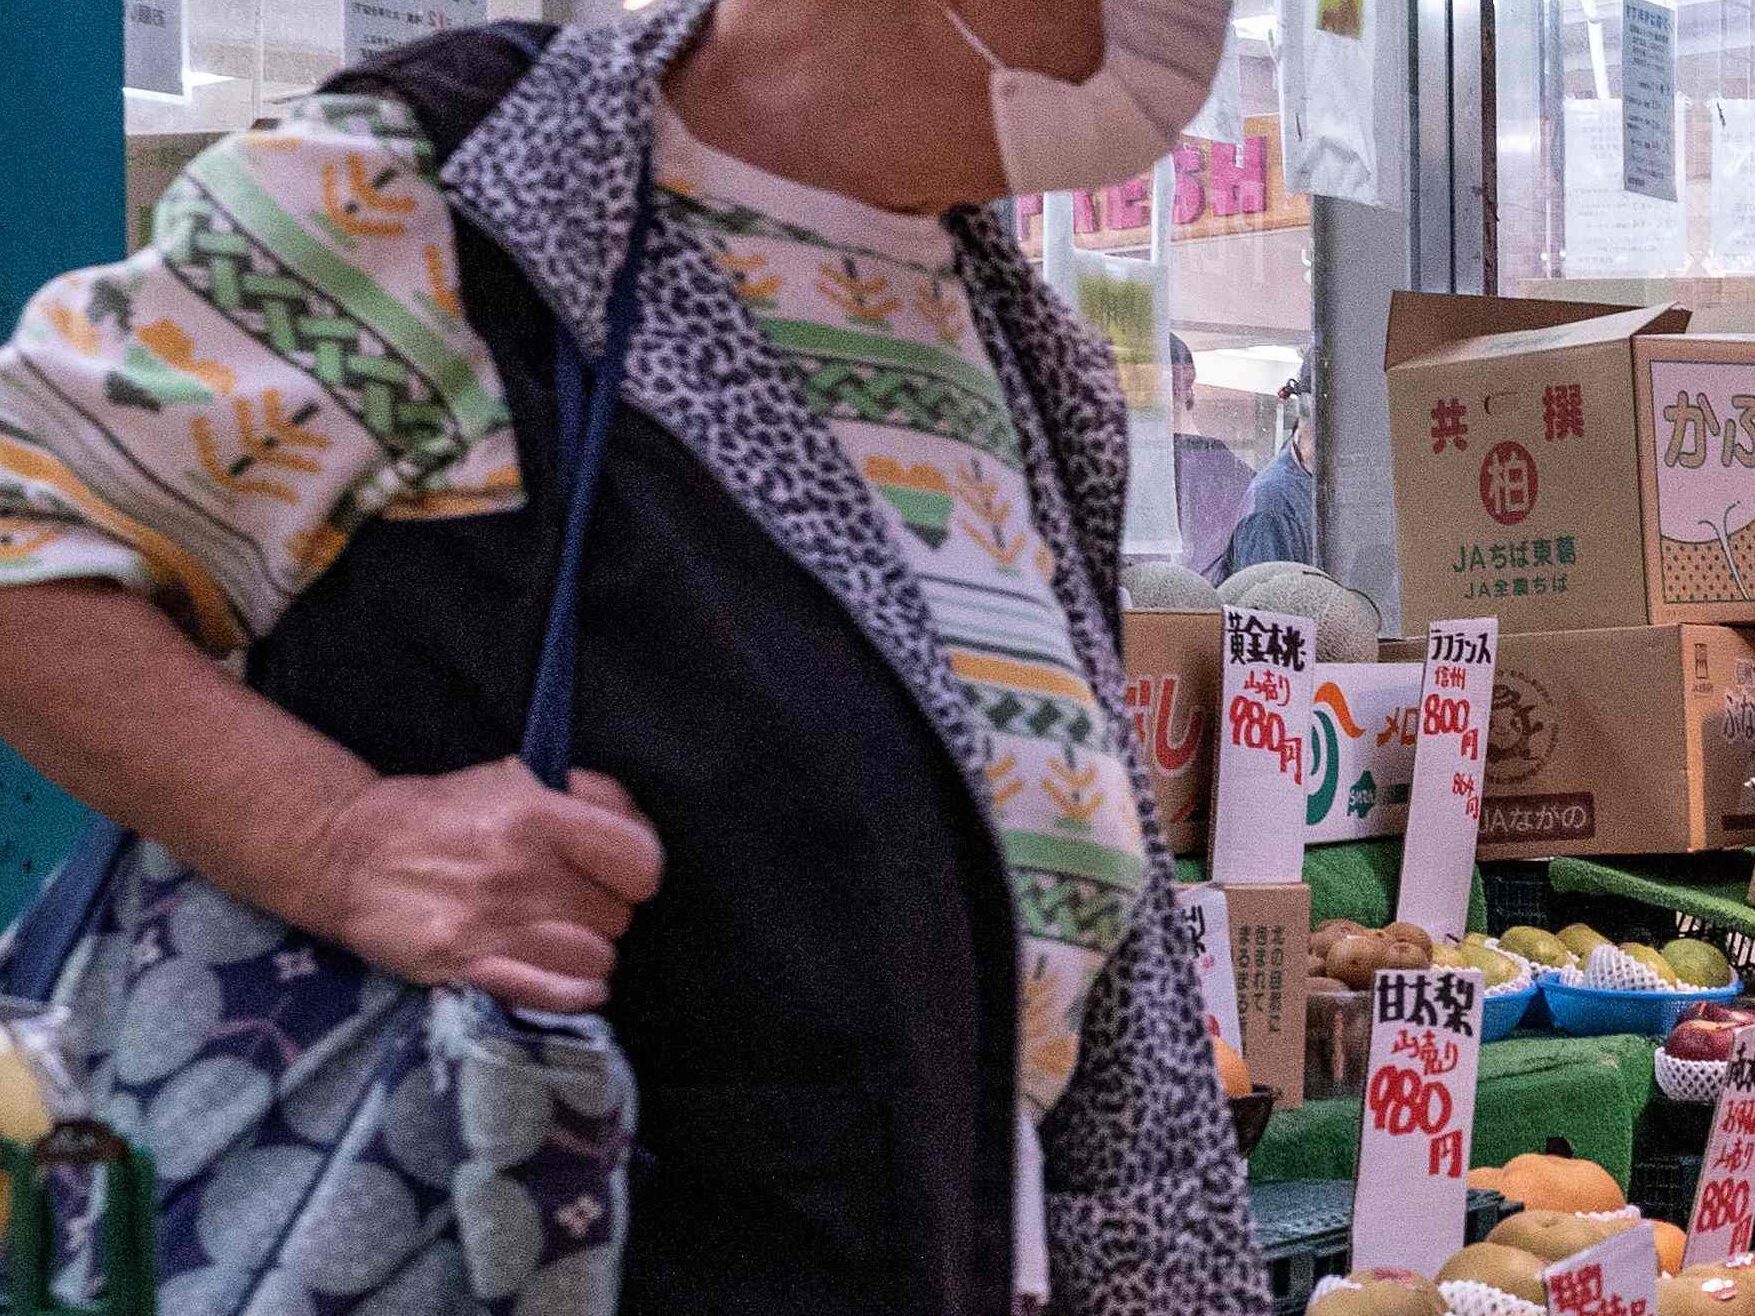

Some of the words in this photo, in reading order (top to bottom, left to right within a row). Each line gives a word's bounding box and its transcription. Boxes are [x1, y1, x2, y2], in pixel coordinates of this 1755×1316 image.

[1453, 535, 1577, 573] JAちば東葛
[1227, 611, 1307, 673] 黄金桃
